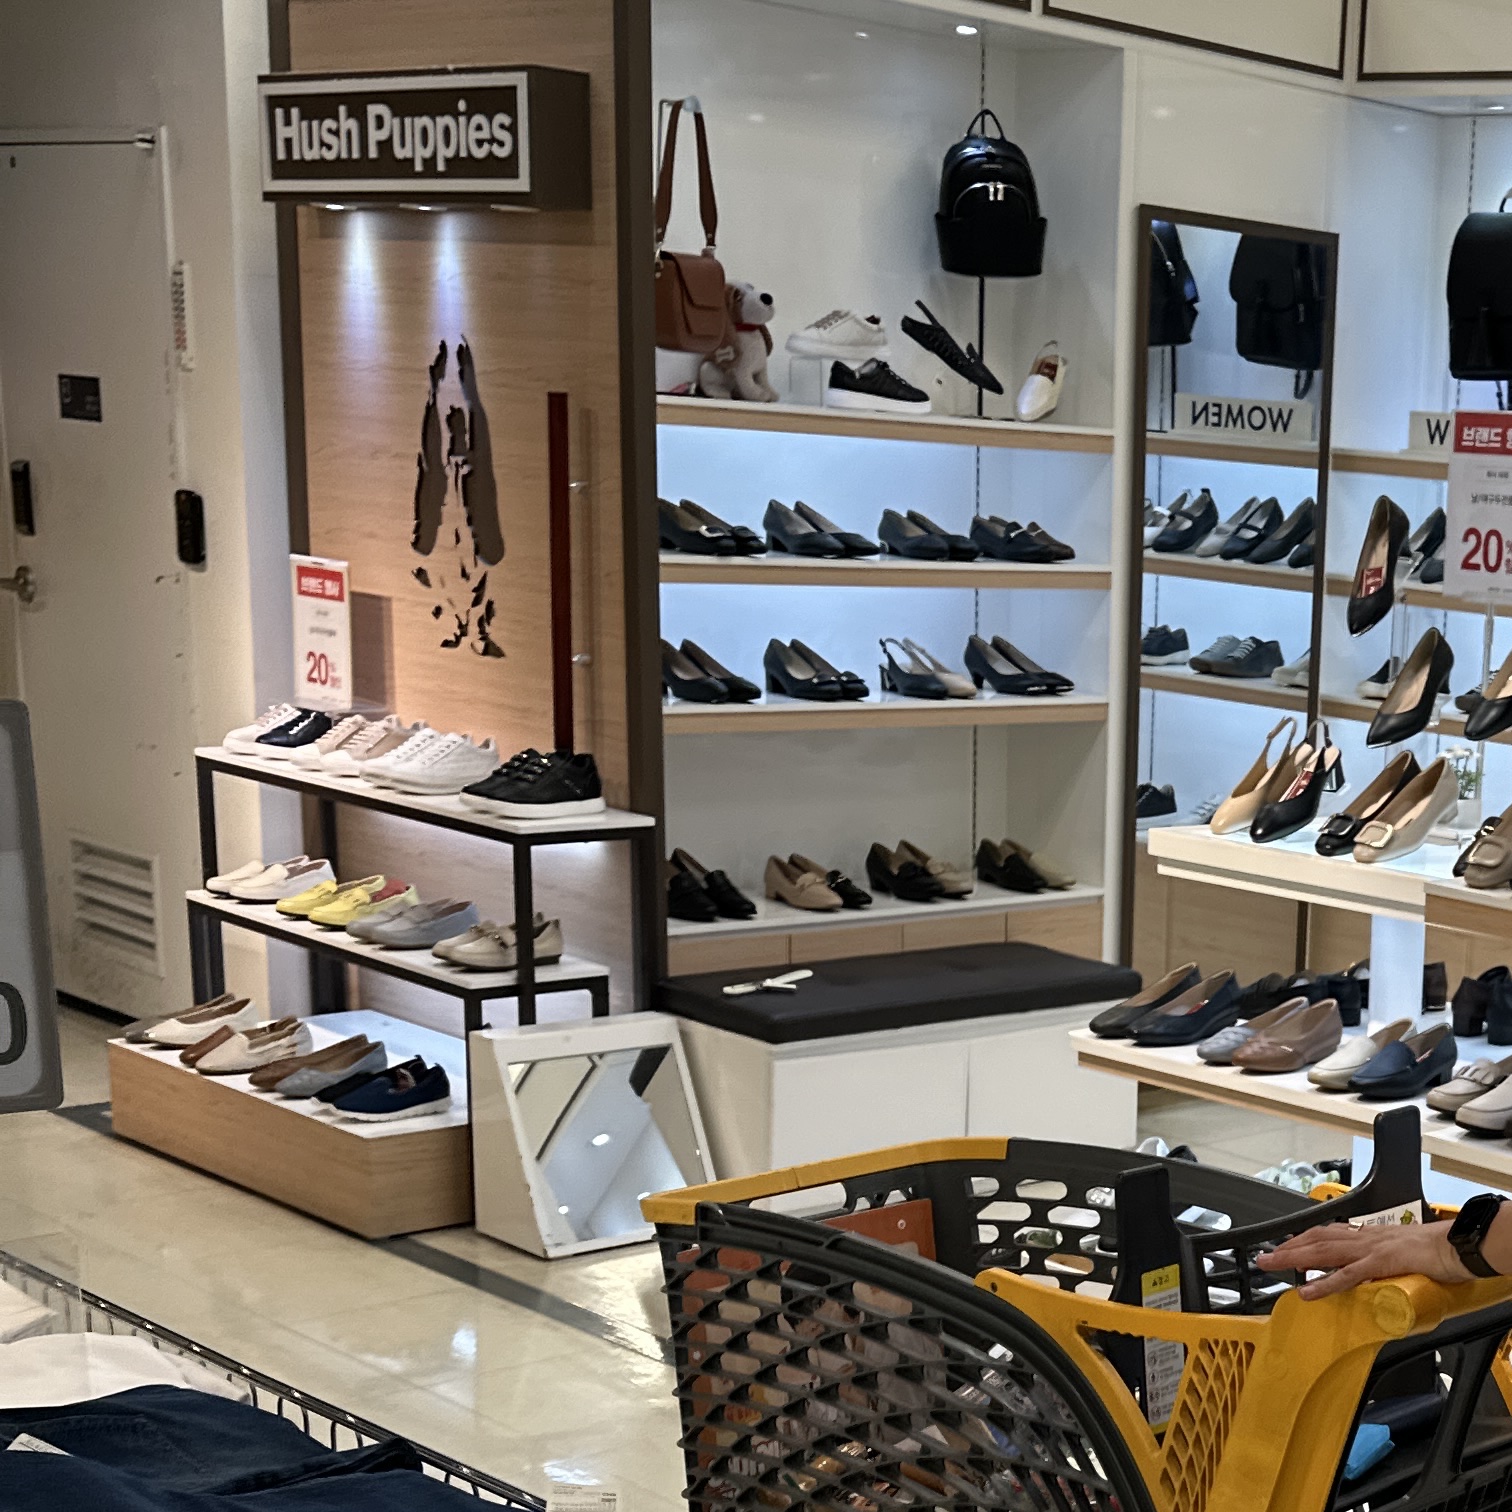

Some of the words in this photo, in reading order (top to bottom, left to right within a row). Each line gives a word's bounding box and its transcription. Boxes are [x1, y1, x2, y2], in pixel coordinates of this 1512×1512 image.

[274, 104, 361, 161] Hush
[366, 98, 513, 173] Puppies
[1461, 426, 1503, 448] 브랜드
